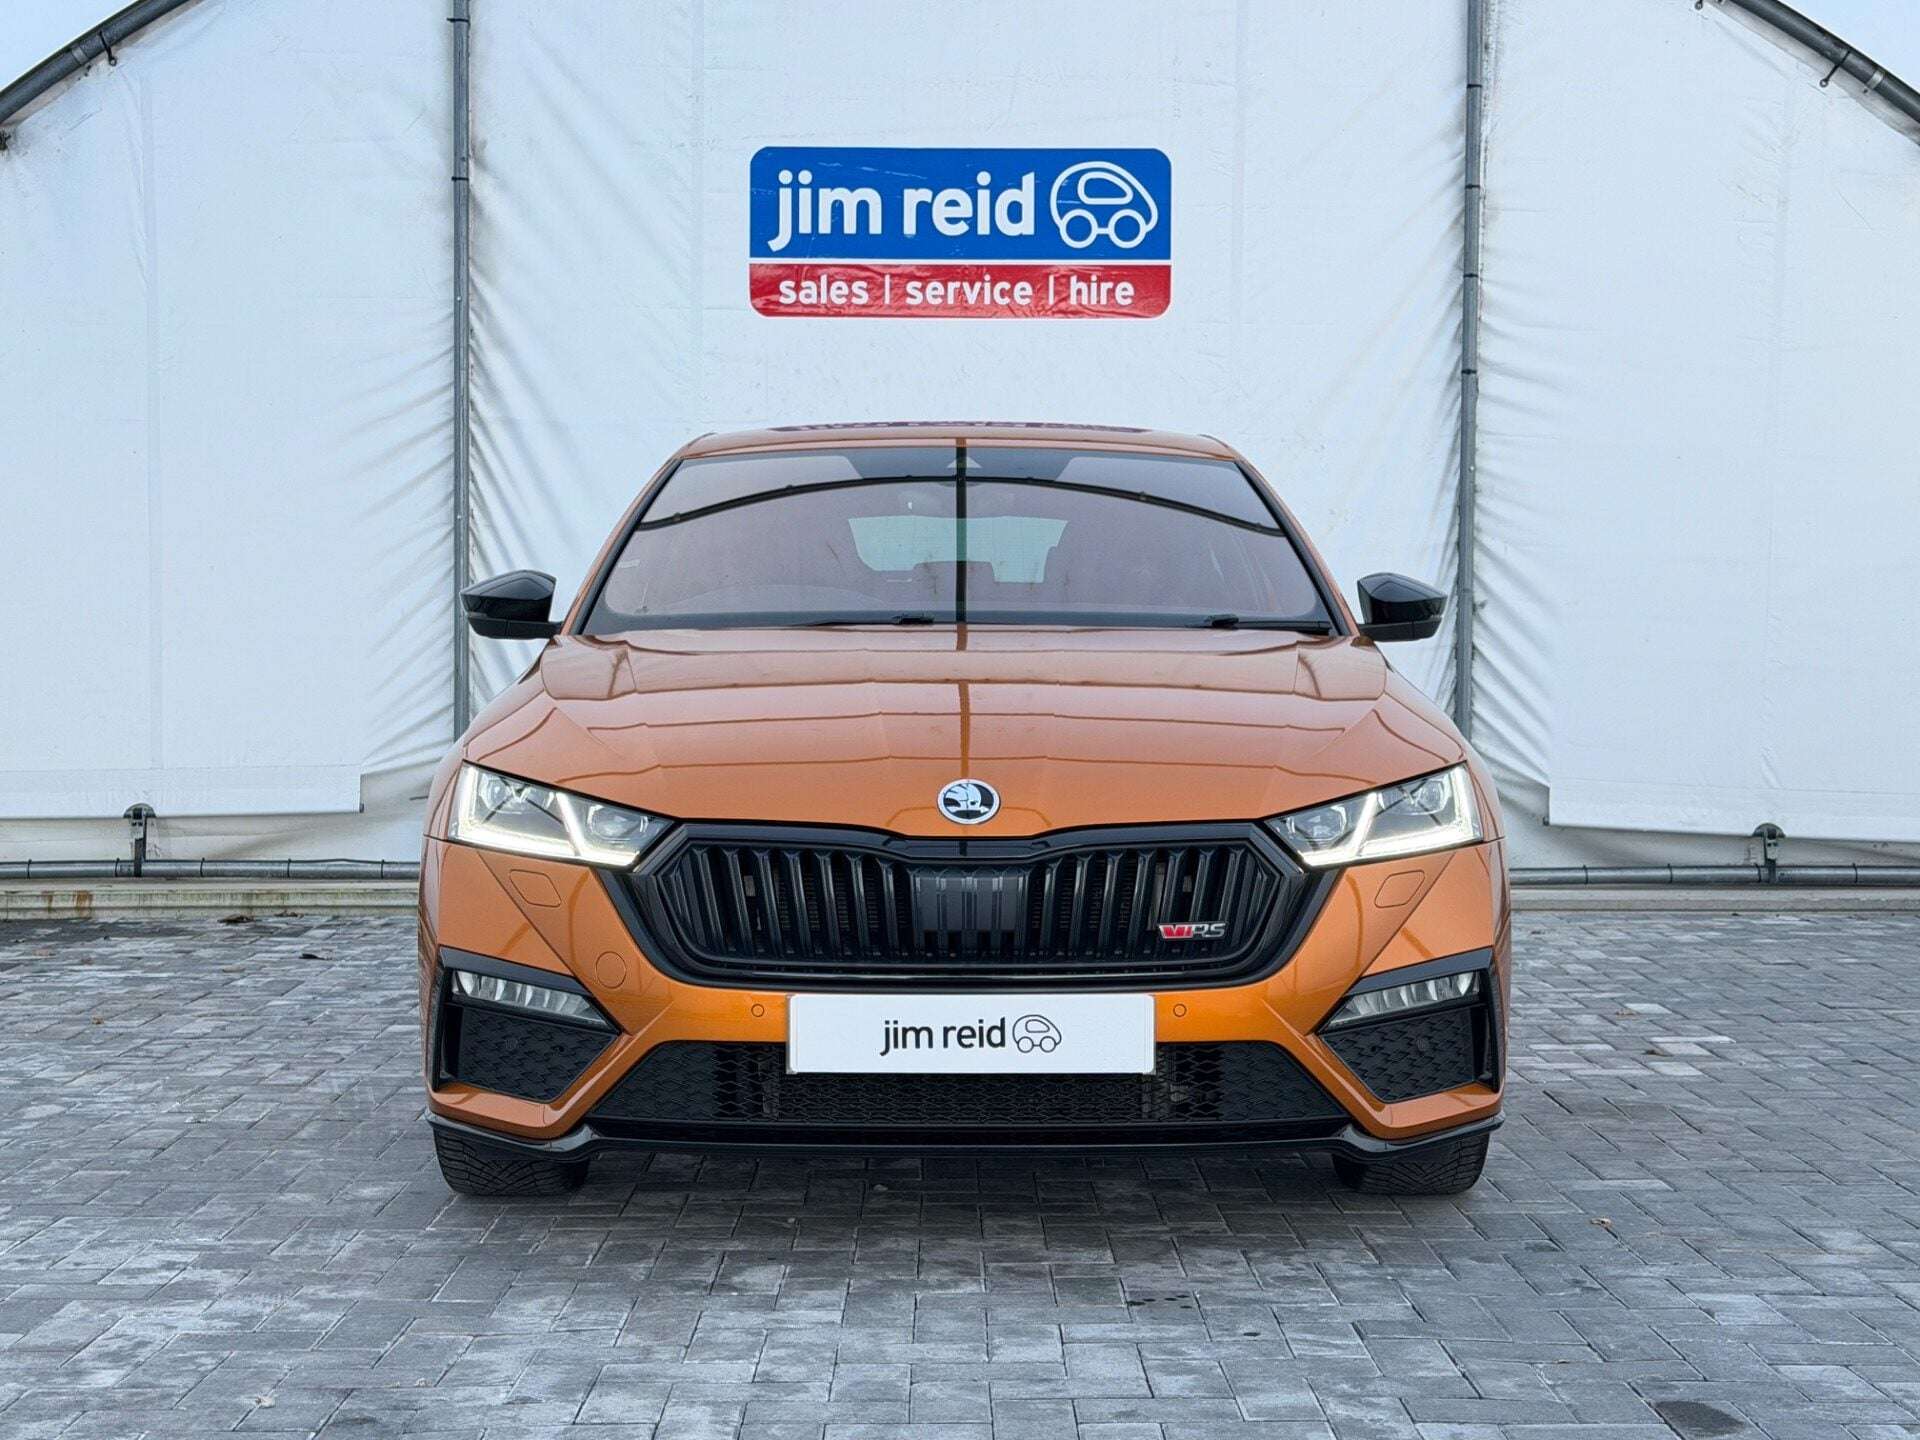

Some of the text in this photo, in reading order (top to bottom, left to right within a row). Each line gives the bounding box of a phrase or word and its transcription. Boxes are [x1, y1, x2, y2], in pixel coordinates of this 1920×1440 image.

[767, 169, 1036, 252] jim reid
[778, 274, 1136, 306] sales service hire
[880, 1017, 1006, 1056] jim reid
